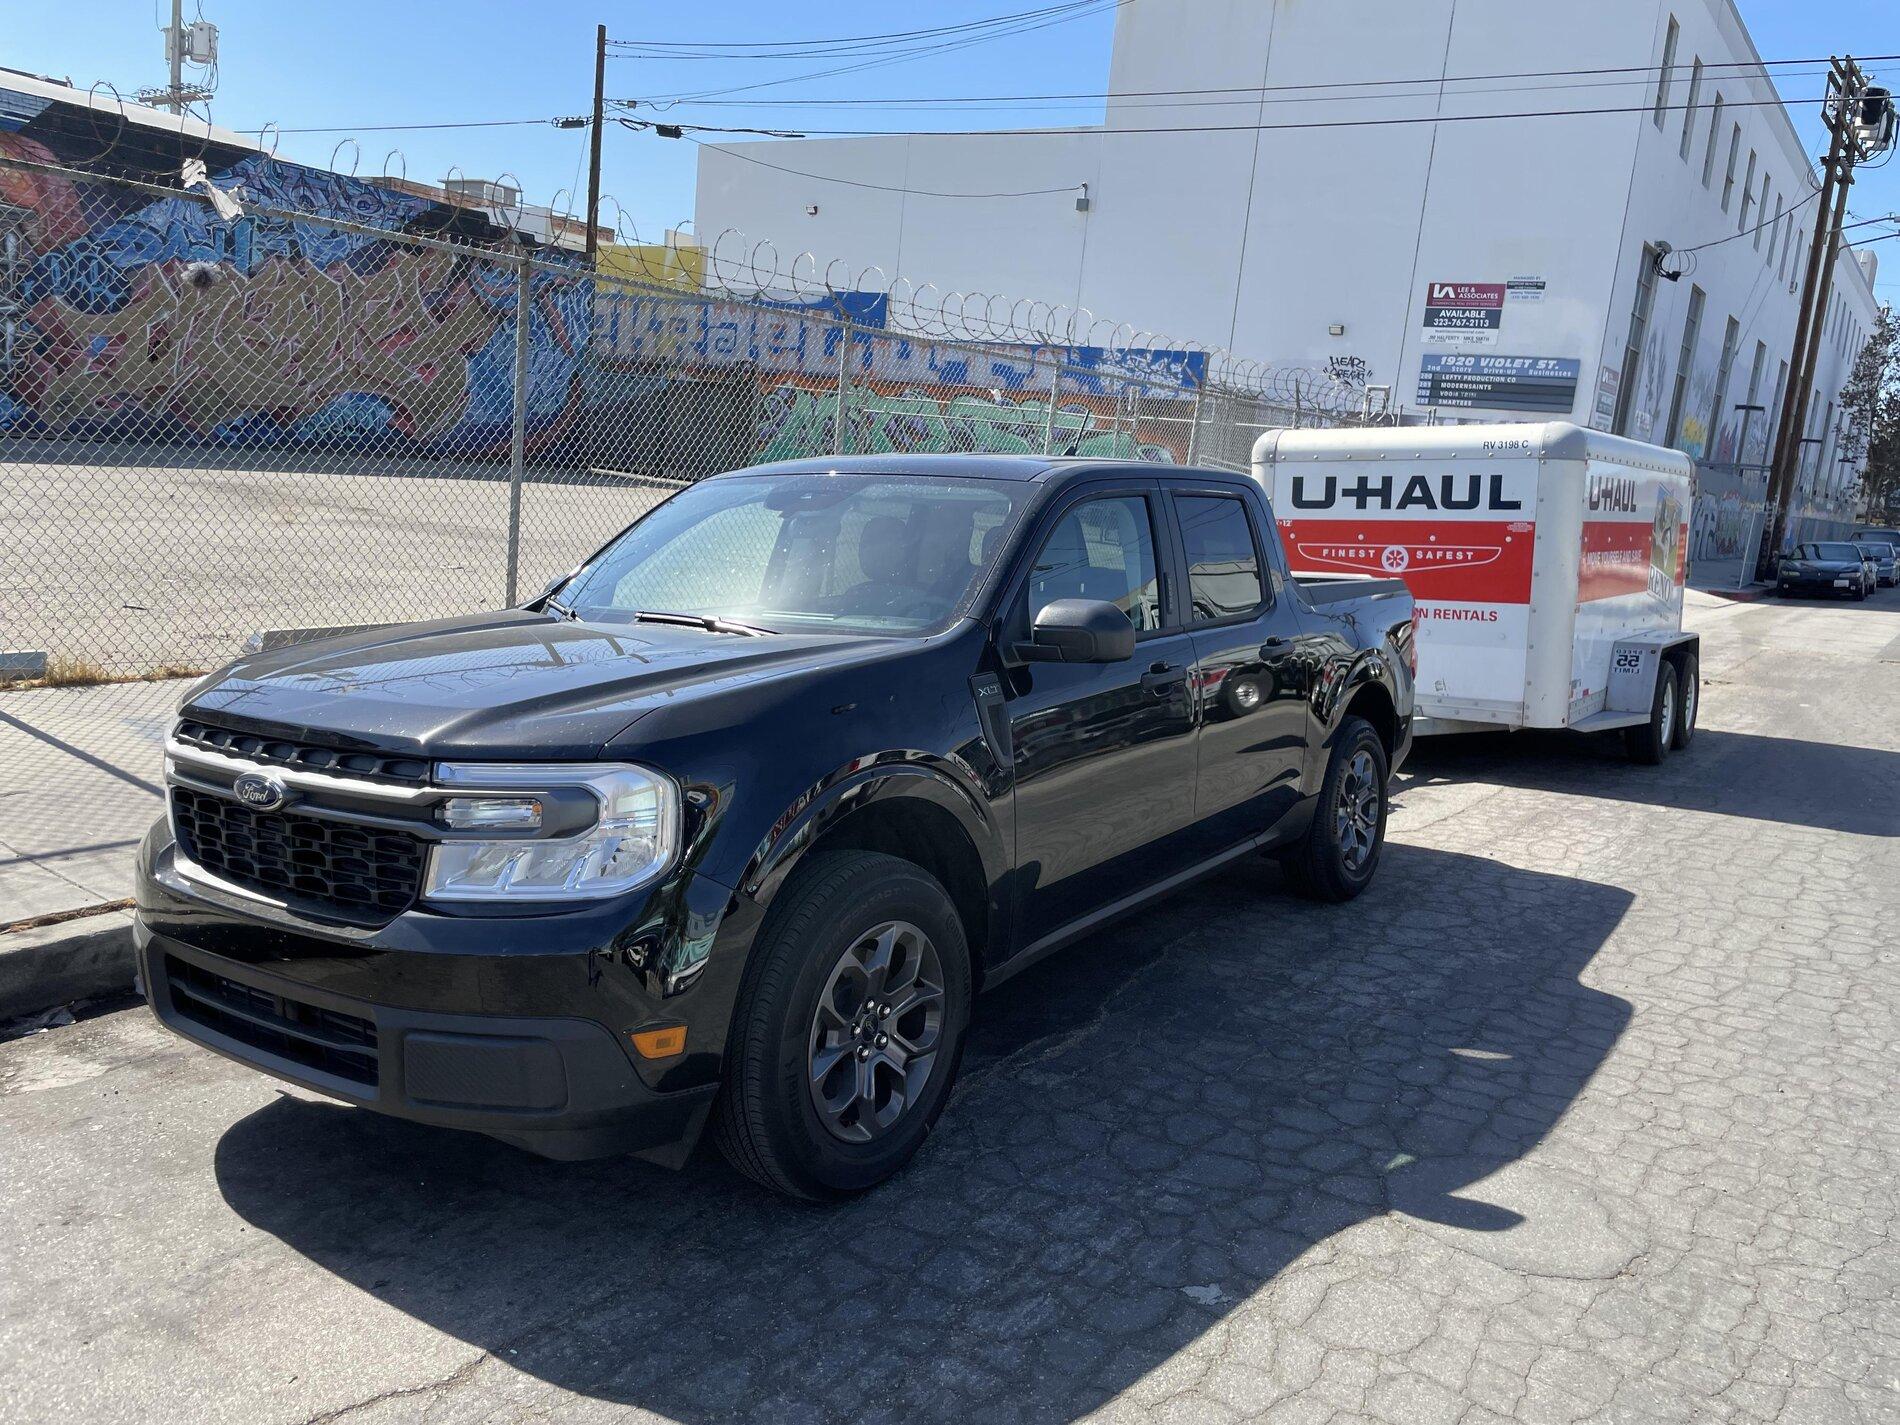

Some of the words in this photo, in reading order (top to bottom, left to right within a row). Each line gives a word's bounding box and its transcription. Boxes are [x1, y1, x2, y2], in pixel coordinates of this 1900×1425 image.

[1439, 310, 1486, 318] AVAILABLE
[1433, 318, 1489, 327] 323-767-2113
[1440, 356, 1475, 366] 1920
[1480, 358, 1532, 368] VIOLET
[1536, 360, 1559, 370] ST.
[1483, 367, 1517, 375] Drive-up
[1528, 369, 1572, 377] Businesses
[1463, 375, 1505, 383] PRODUCTION
[1483, 440, 1496, 450] RV
[1498, 440, 1519, 450] 3198
[1521, 439, 1529, 448] C
[1292, 474, 1522, 510] U-HAUL
[1589, 475, 1637, 513] U-HAUL
[1322, 549, 1376, 558] FINEST
[1416, 550, 1474, 560] SAFEST
[1648, 565, 1671, 602] RENO
[1433, 608, 1498, 622] RENTALS
[977, 684, 999, 697] XLT
[242, 781, 269, 803] Ford
